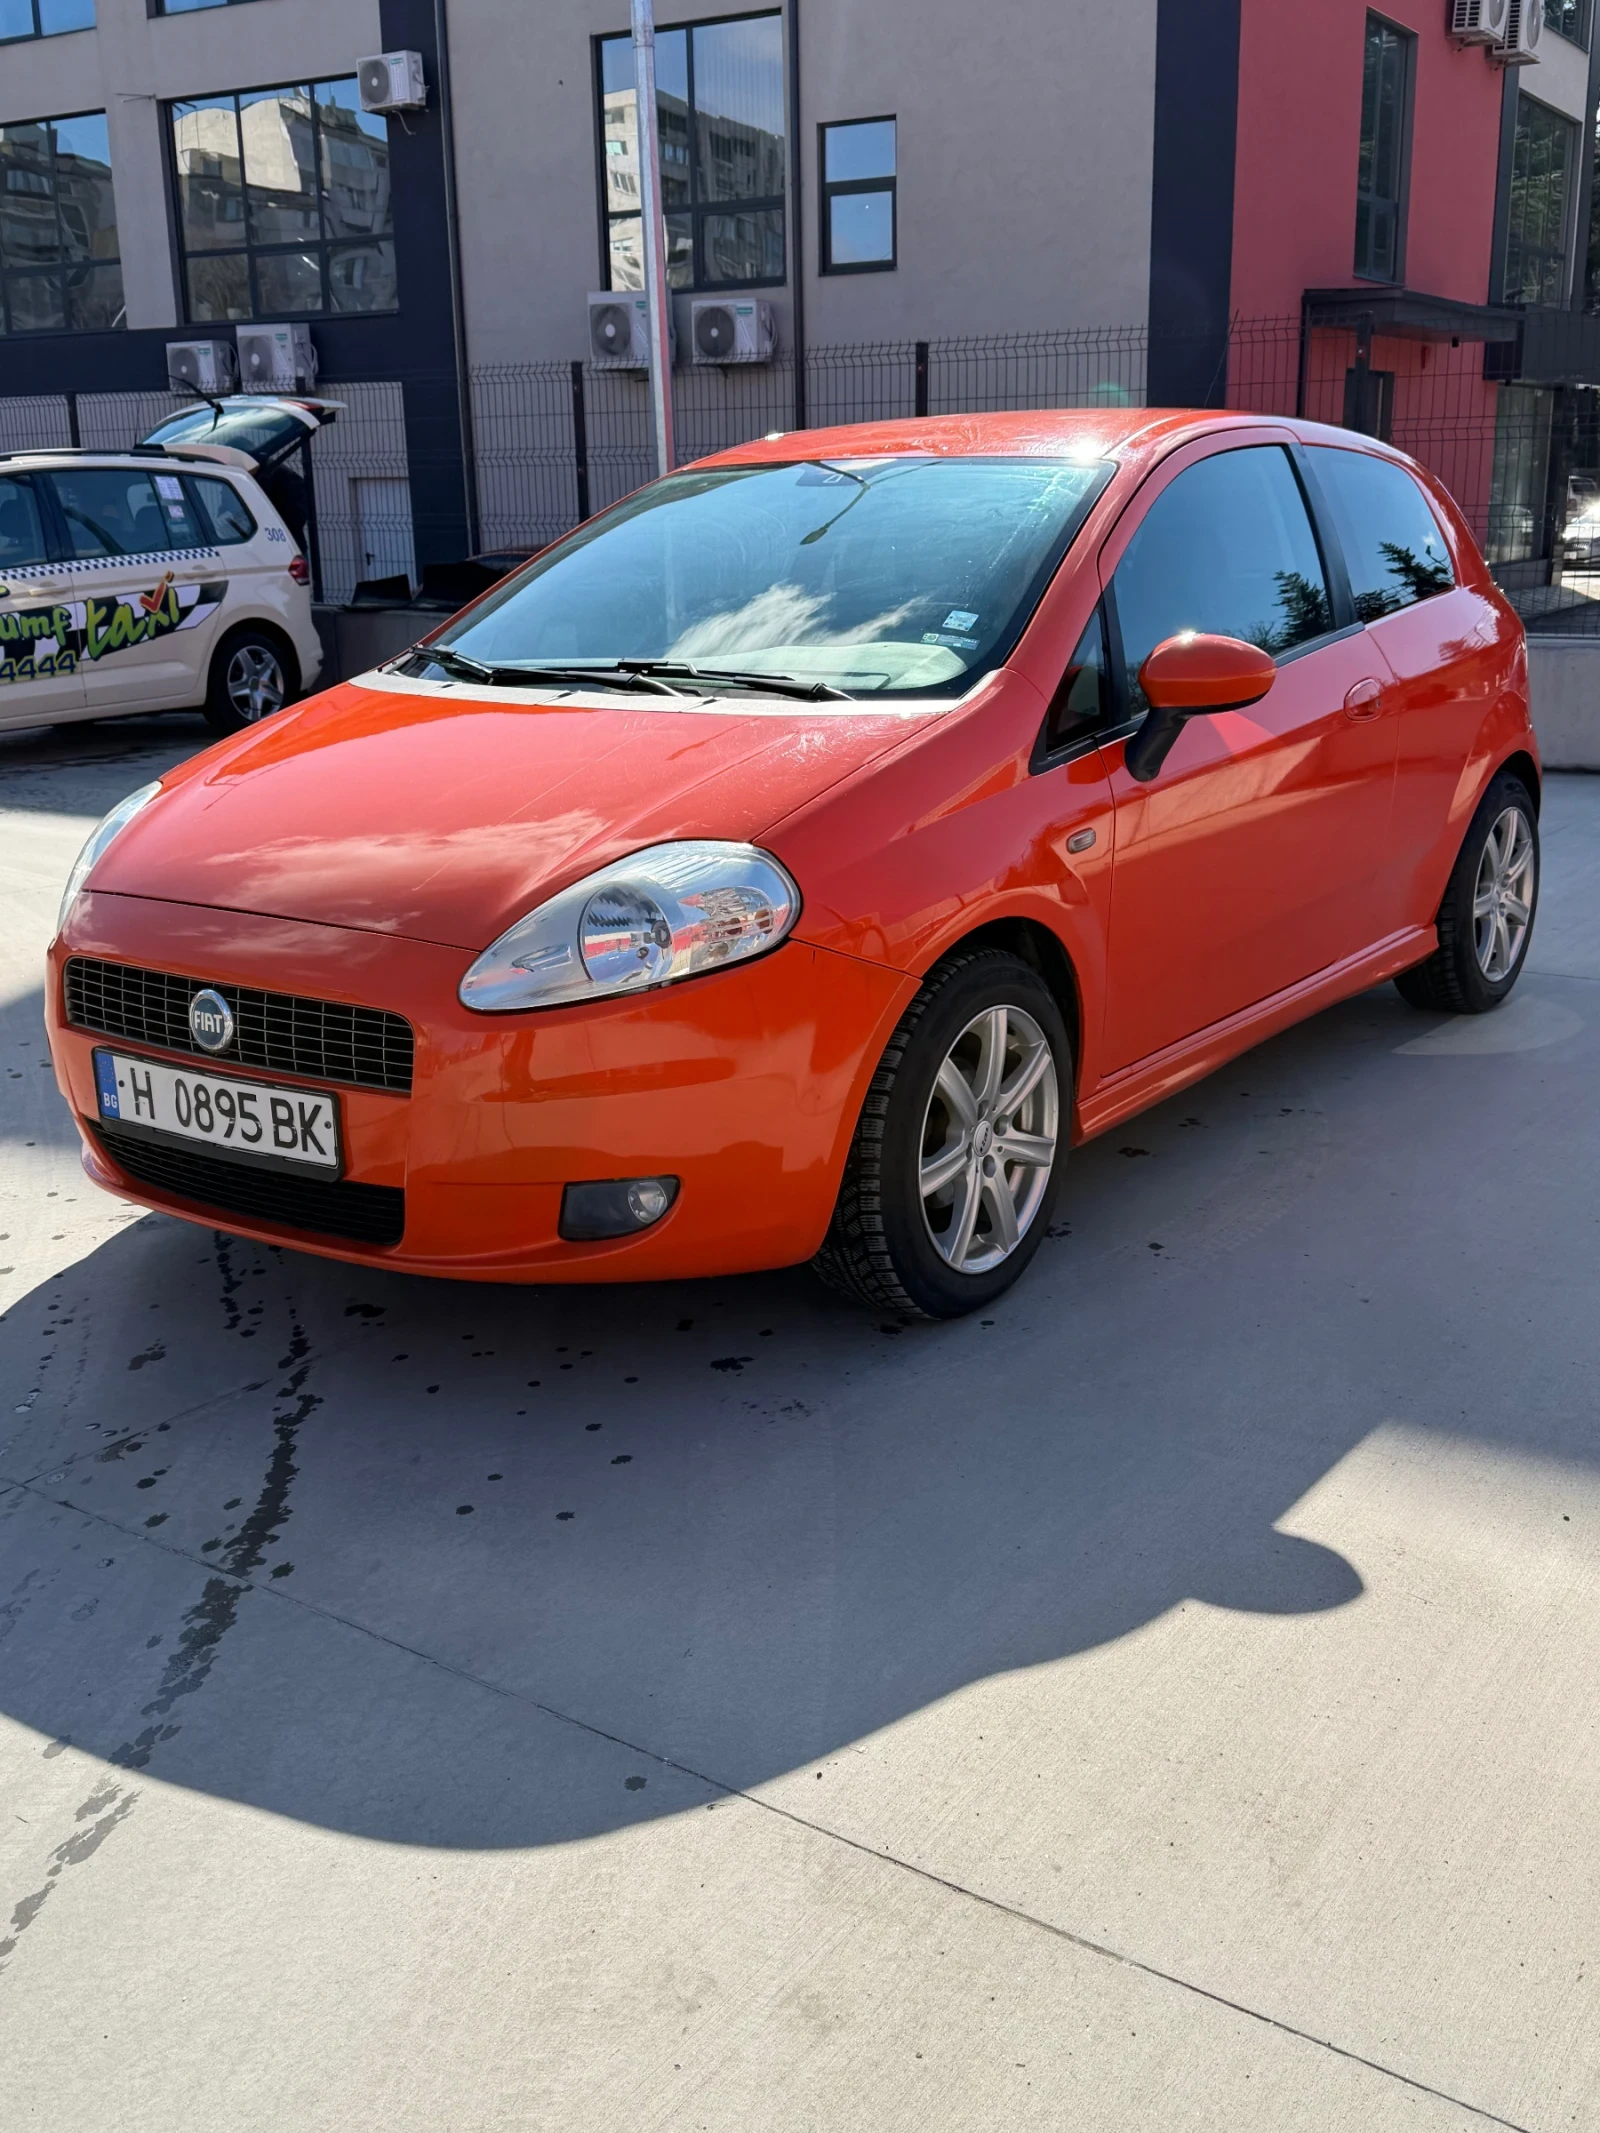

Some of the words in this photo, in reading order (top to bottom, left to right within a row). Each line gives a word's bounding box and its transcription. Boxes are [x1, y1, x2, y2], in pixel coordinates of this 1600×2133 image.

[264, 527, 287, 542] 308
[86, 571, 180, 662] taxi
[194, 1010, 223, 1034] FIAT
[103, 1092, 118, 1109] BG
[130, 1067, 155, 1120] H
[174, 1078, 263, 1143] 0895
[269, 1097, 327, 1156] BK
